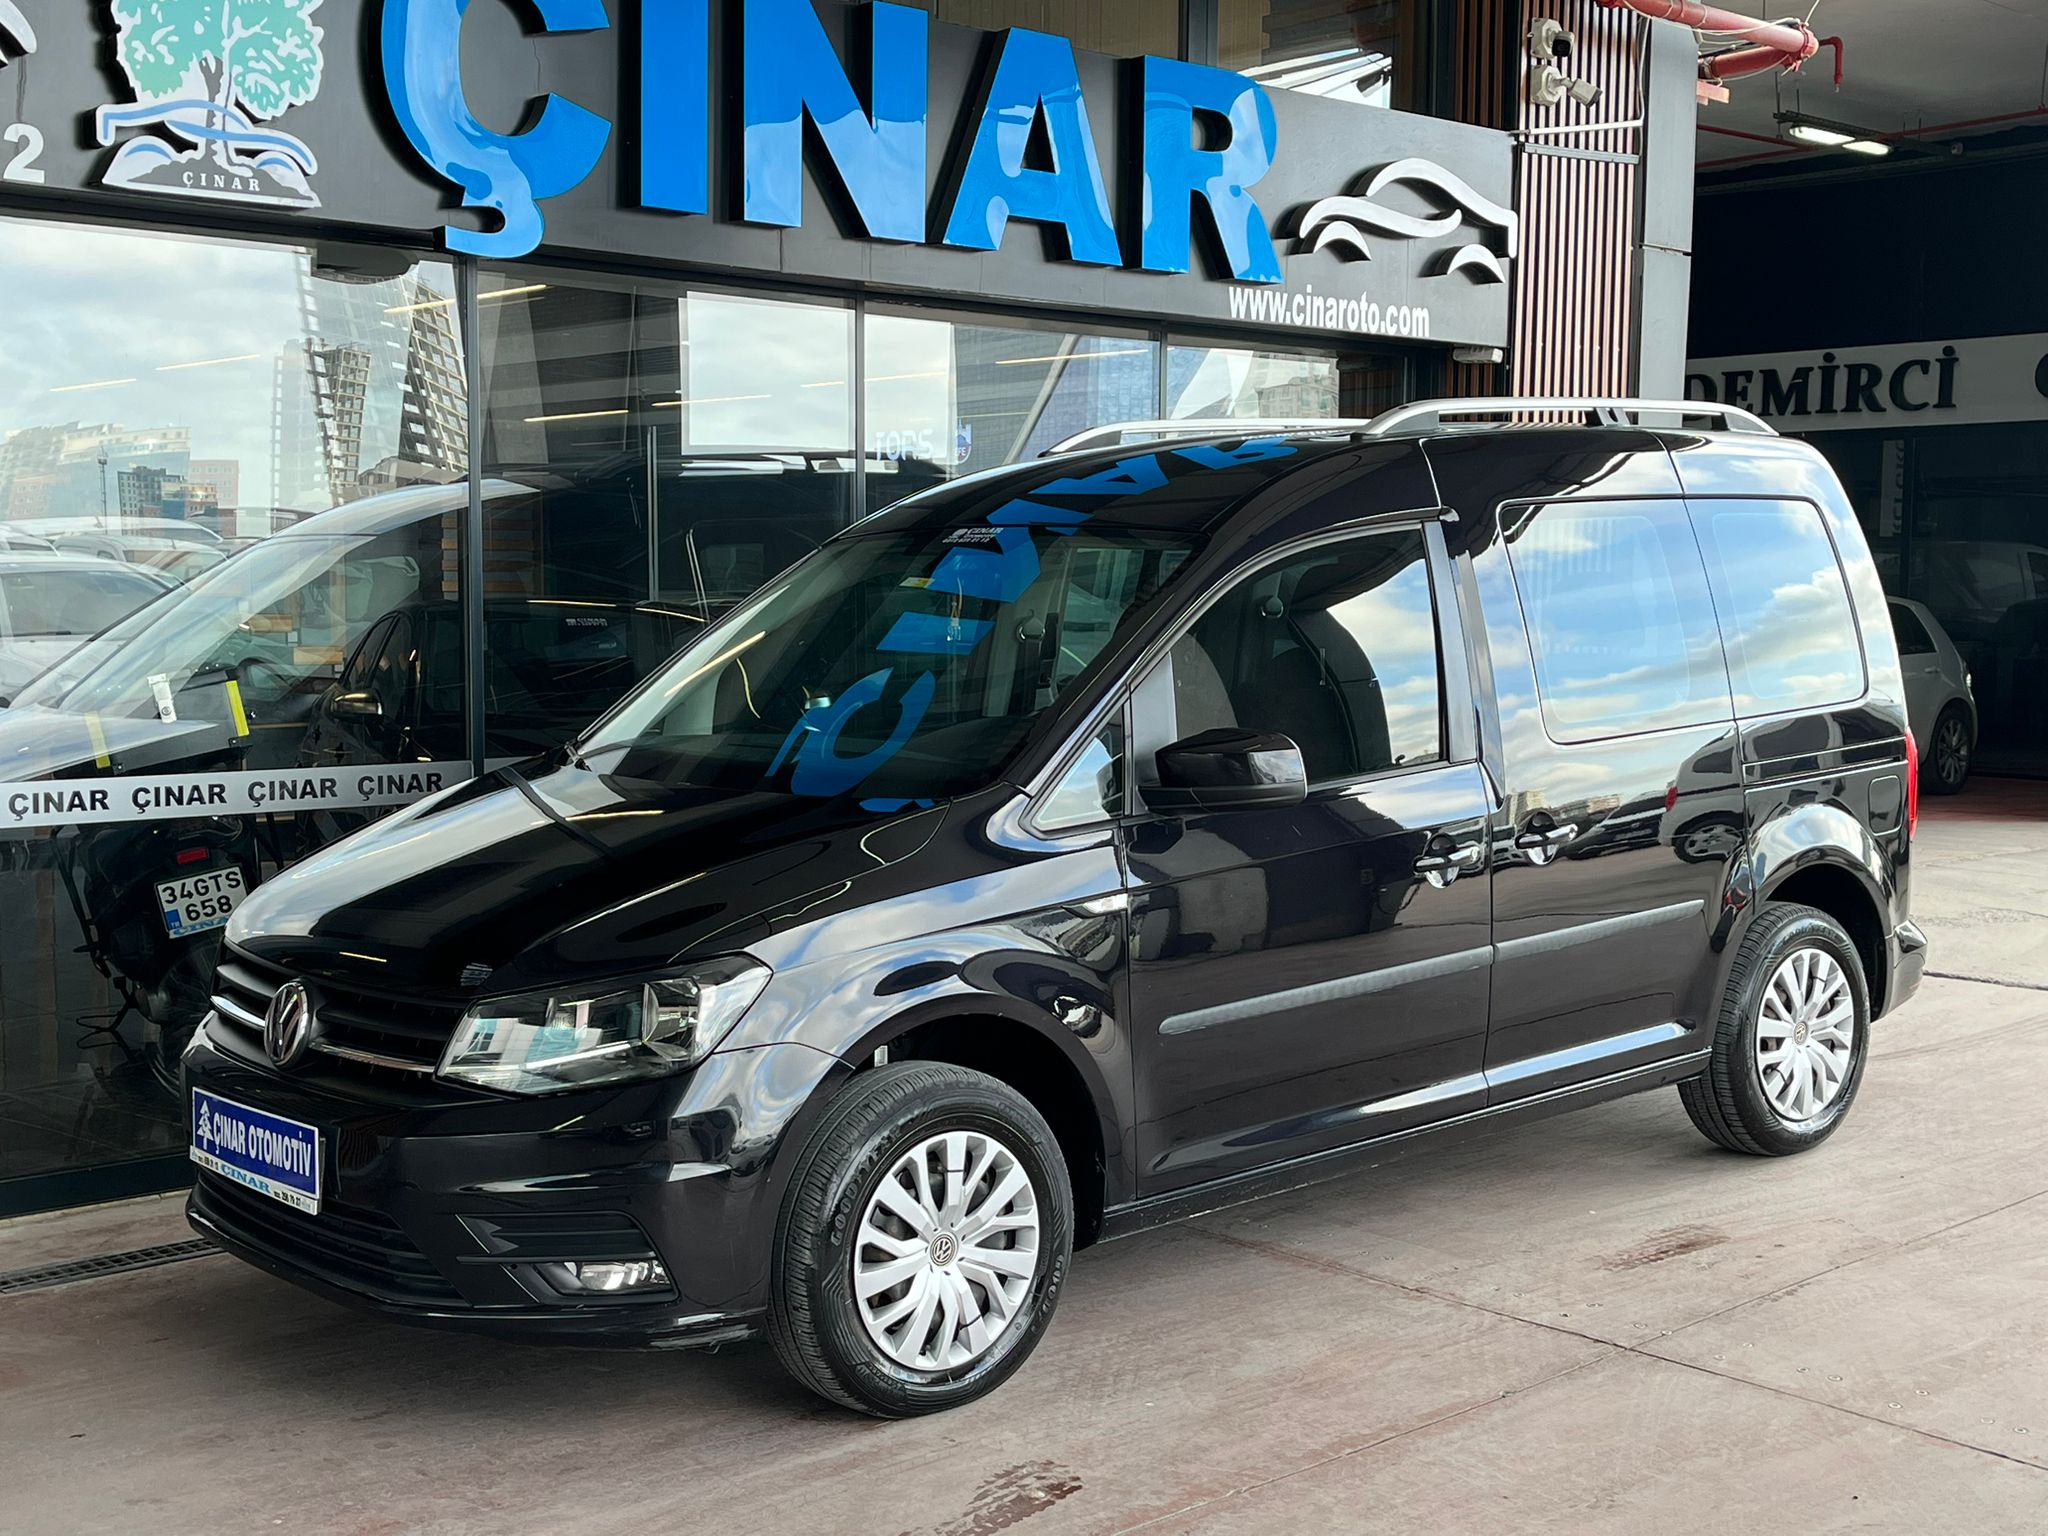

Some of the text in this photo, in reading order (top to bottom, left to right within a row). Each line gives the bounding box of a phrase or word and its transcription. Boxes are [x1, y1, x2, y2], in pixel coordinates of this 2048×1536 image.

[3, 123, 46, 184] 2
[382, 0, 1283, 284] ÇINAR
[182, 171, 261, 191] ÇINAR
[1228, 284, 1430, 337] www.cinaroto.com
[8, 772, 443, 822] ÇINAR ÇINAR ÇINAR ÇINAR
[162, 871, 241, 904] 34GTS
[185, 895, 233, 921] 658
[213, 1111, 312, 1178] ÇINAR OTOMOTİV
[220, 1163, 272, 1194] ÇINAR
